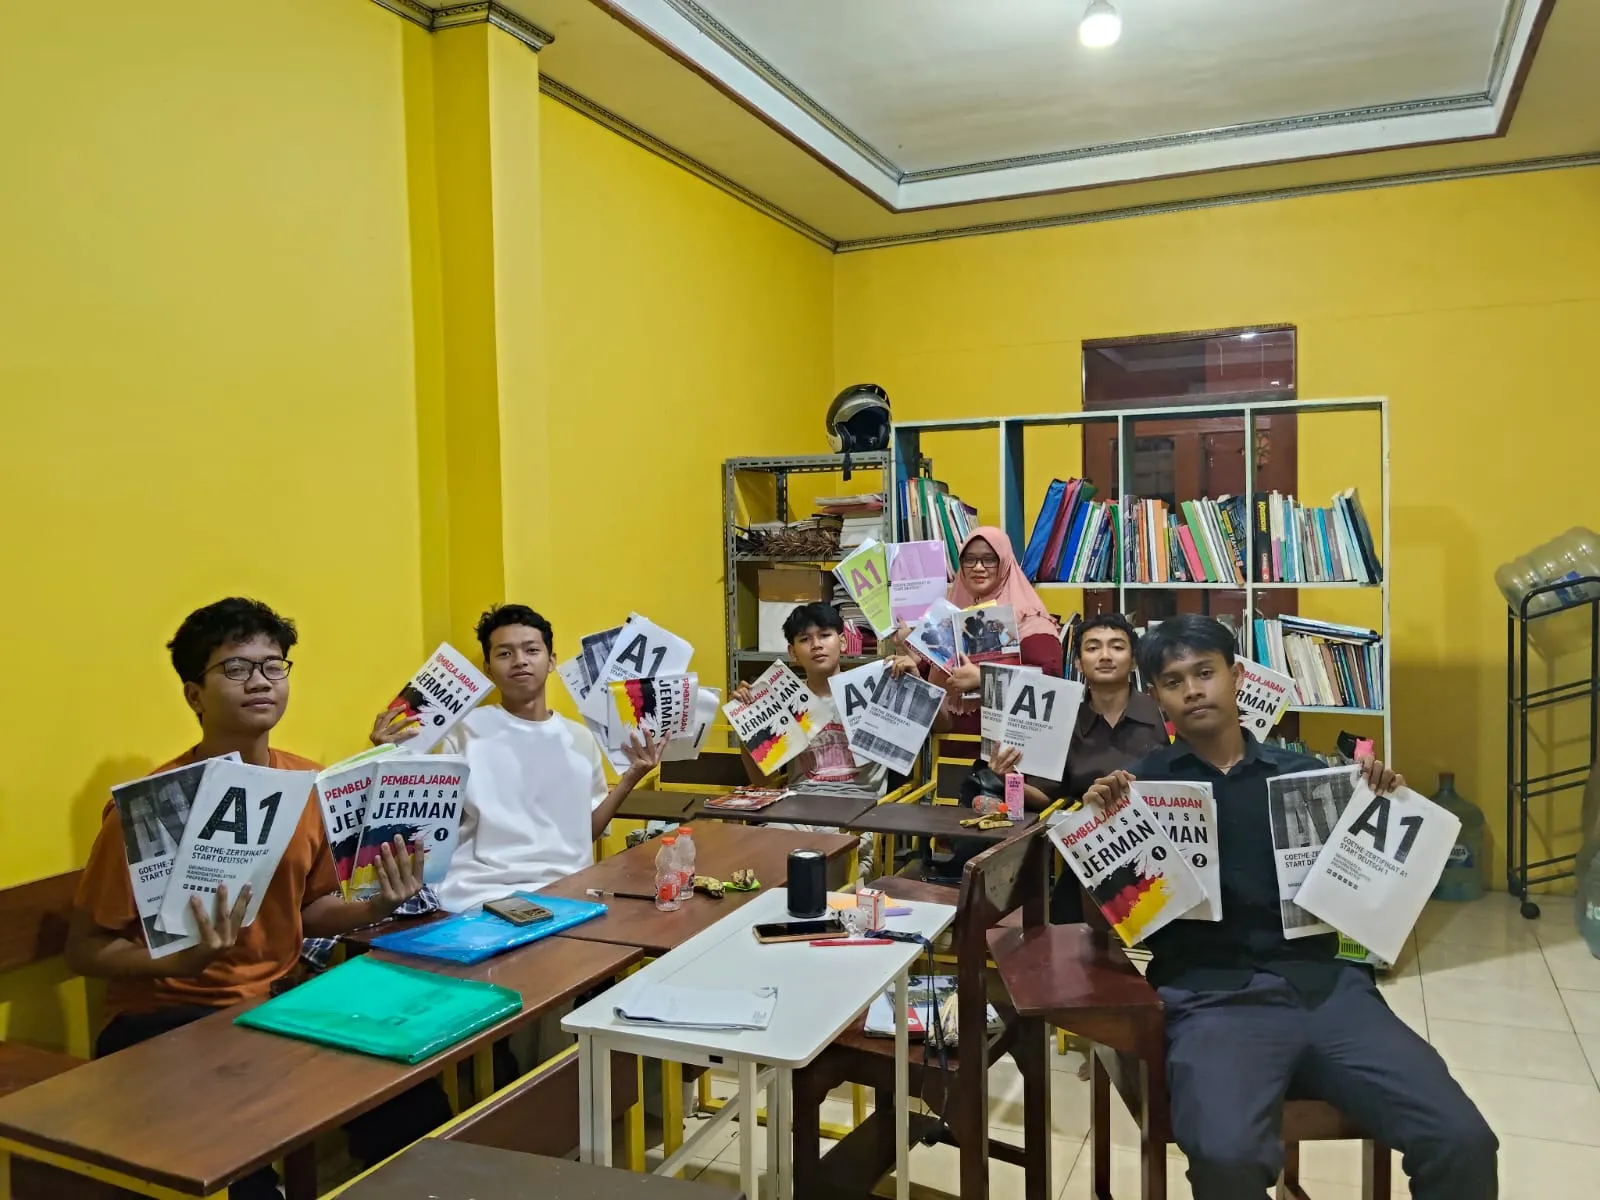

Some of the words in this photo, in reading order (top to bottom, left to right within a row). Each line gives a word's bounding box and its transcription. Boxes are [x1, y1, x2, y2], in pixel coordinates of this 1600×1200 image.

[851, 559, 882, 597] A1
[616, 633, 667, 678] A1
[416, 671, 463, 714] JERMAN
[1010, 685, 1056, 722] A1
[742, 701, 782, 736] JERMAN
[379, 790, 458, 798] BAHASA
[381, 775, 460, 786] PEMBELAJARAN
[198, 786, 282, 845] A1
[372, 802, 457, 820] JERMAN
[1072, 808, 1142, 860] BAHASA
[1348, 795, 1424, 864] A1
[192, 852, 216, 862] START
[217, 856, 249, 864] DEUTSCH
[1083, 820, 1156, 878] JERMAN
[1154, 847, 1165, 859] 1
[1194, 854, 1206, 866] 2
[1286, 860, 1304, 868] START
[1340, 842, 1357, 858] START
[1358, 854, 1384, 874] DEUTSCH
[140, 870, 164, 882] START
